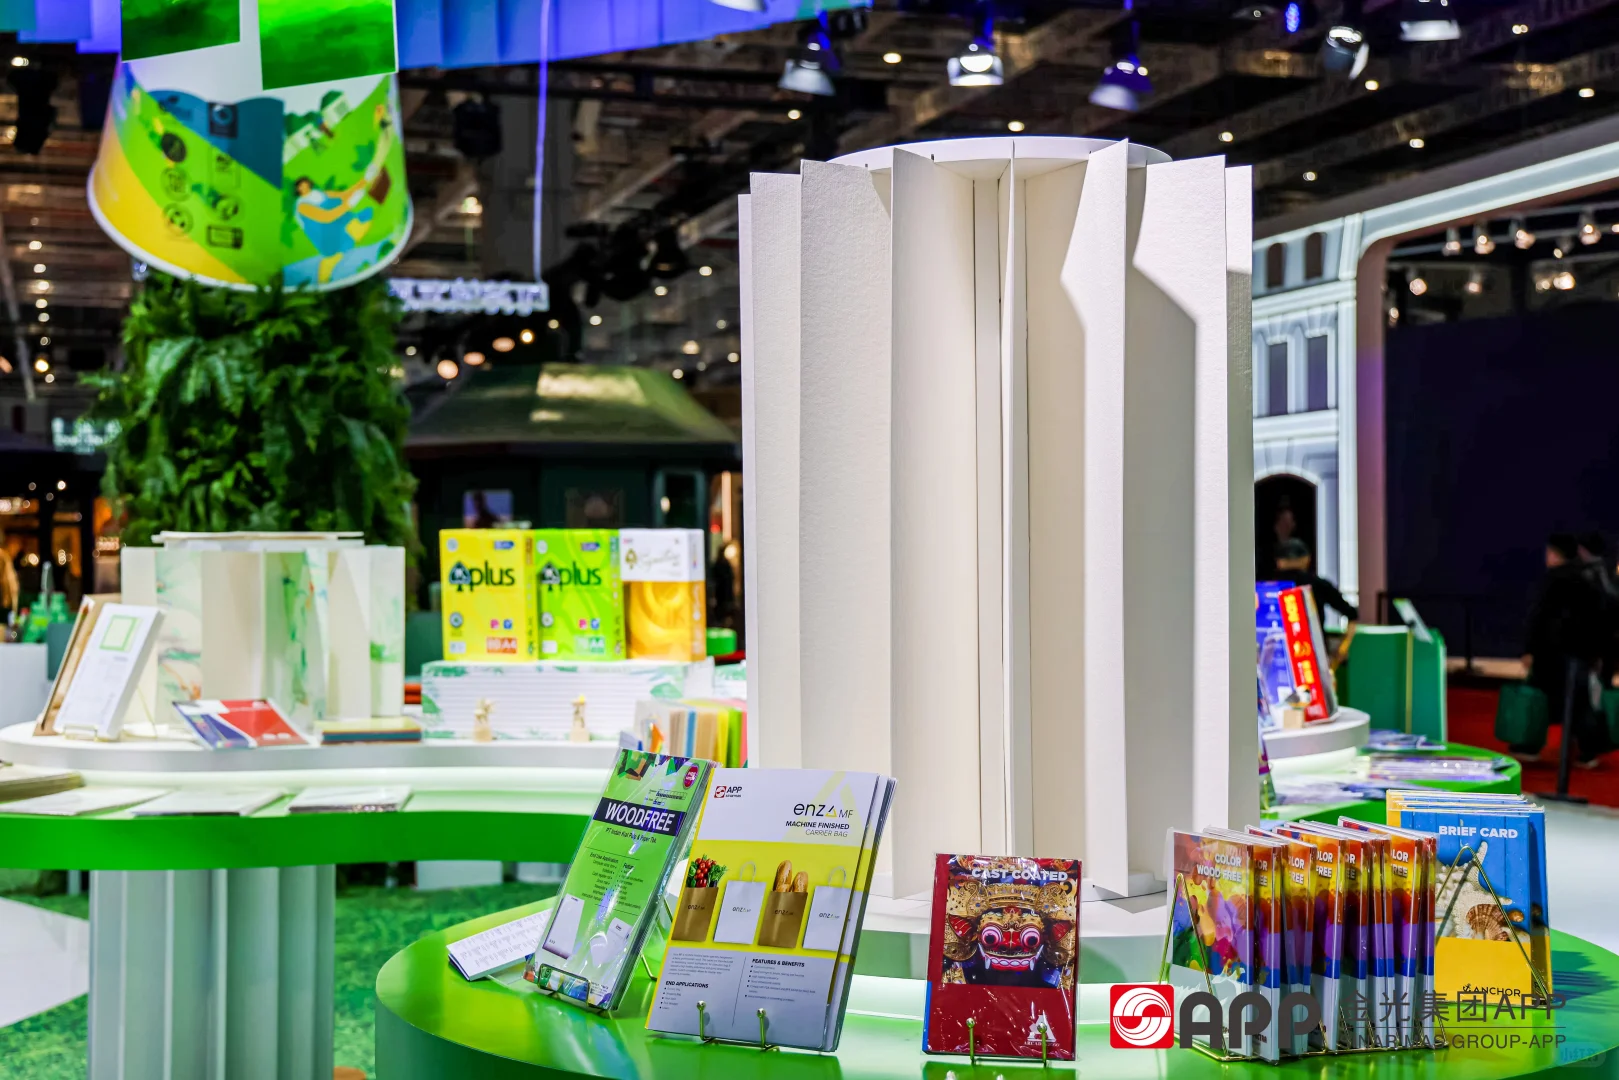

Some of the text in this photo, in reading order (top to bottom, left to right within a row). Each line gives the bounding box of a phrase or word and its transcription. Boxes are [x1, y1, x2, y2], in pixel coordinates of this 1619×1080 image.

[726, 786, 742, 794] APP
[605, 801, 676, 832] WOODFREE
[839, 809, 853, 819] MF
[785, 820, 850, 830] MACHINE FINISHED
[805, 829, 848, 838] CARRIER BAG
[1438, 825, 1518, 839] BRIEF CARD
[1215, 853, 1242, 867] COLOR
[971, 868, 1068, 882] CAST COATED
[1196, 864, 1242, 883] WOOD FREE
[1473, 986, 1521, 997] ANCHOR
